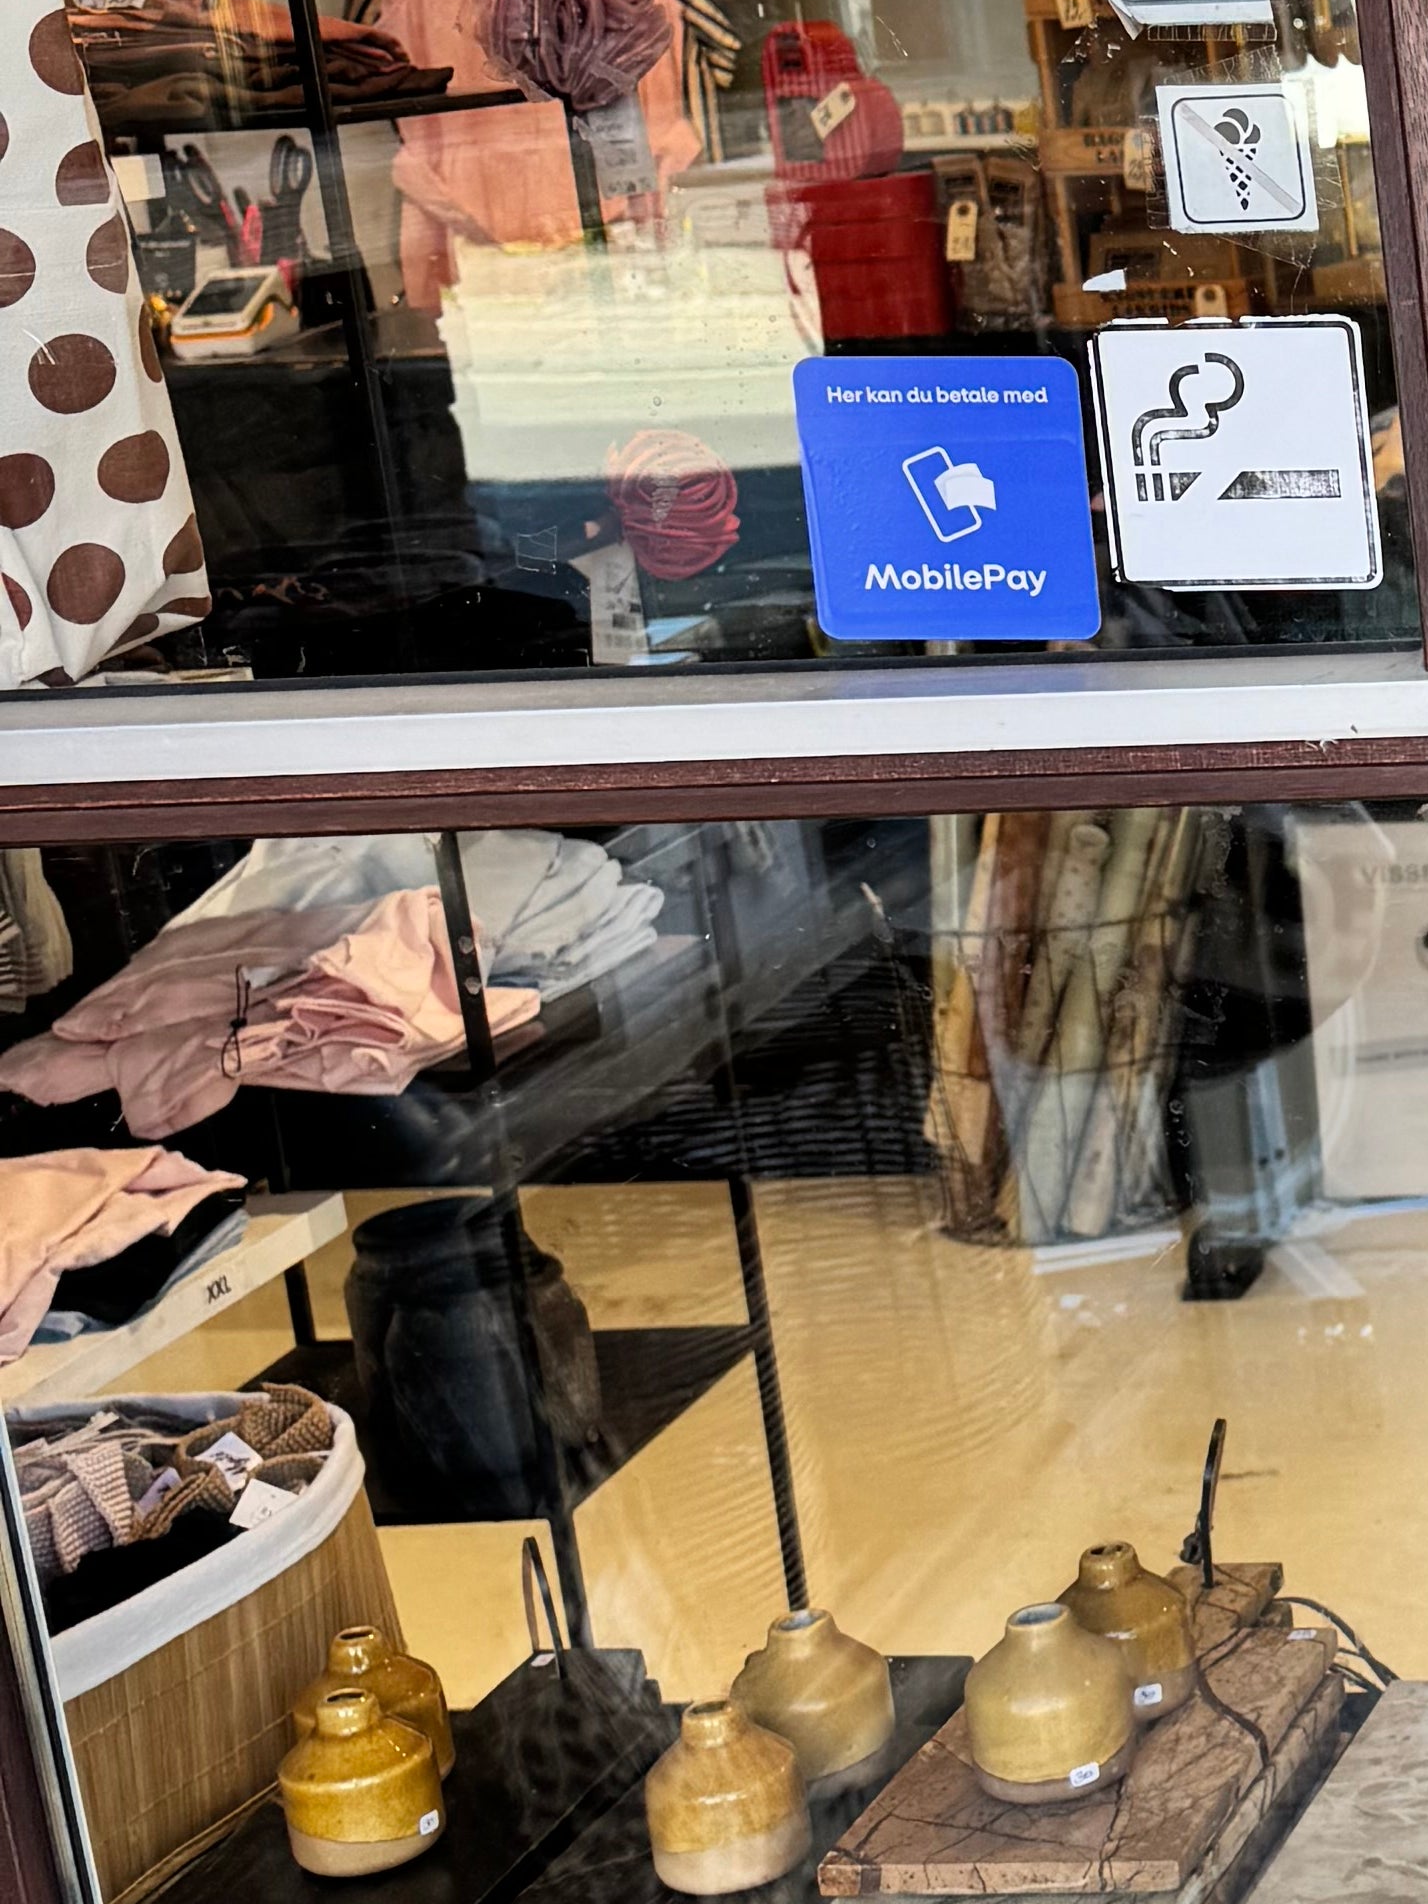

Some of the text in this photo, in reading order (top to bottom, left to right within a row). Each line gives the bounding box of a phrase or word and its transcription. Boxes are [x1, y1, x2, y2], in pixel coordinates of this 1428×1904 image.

[826, 385, 1049, 404] Her kan du betale med
[864, 563, 1048, 598] MobilePay
